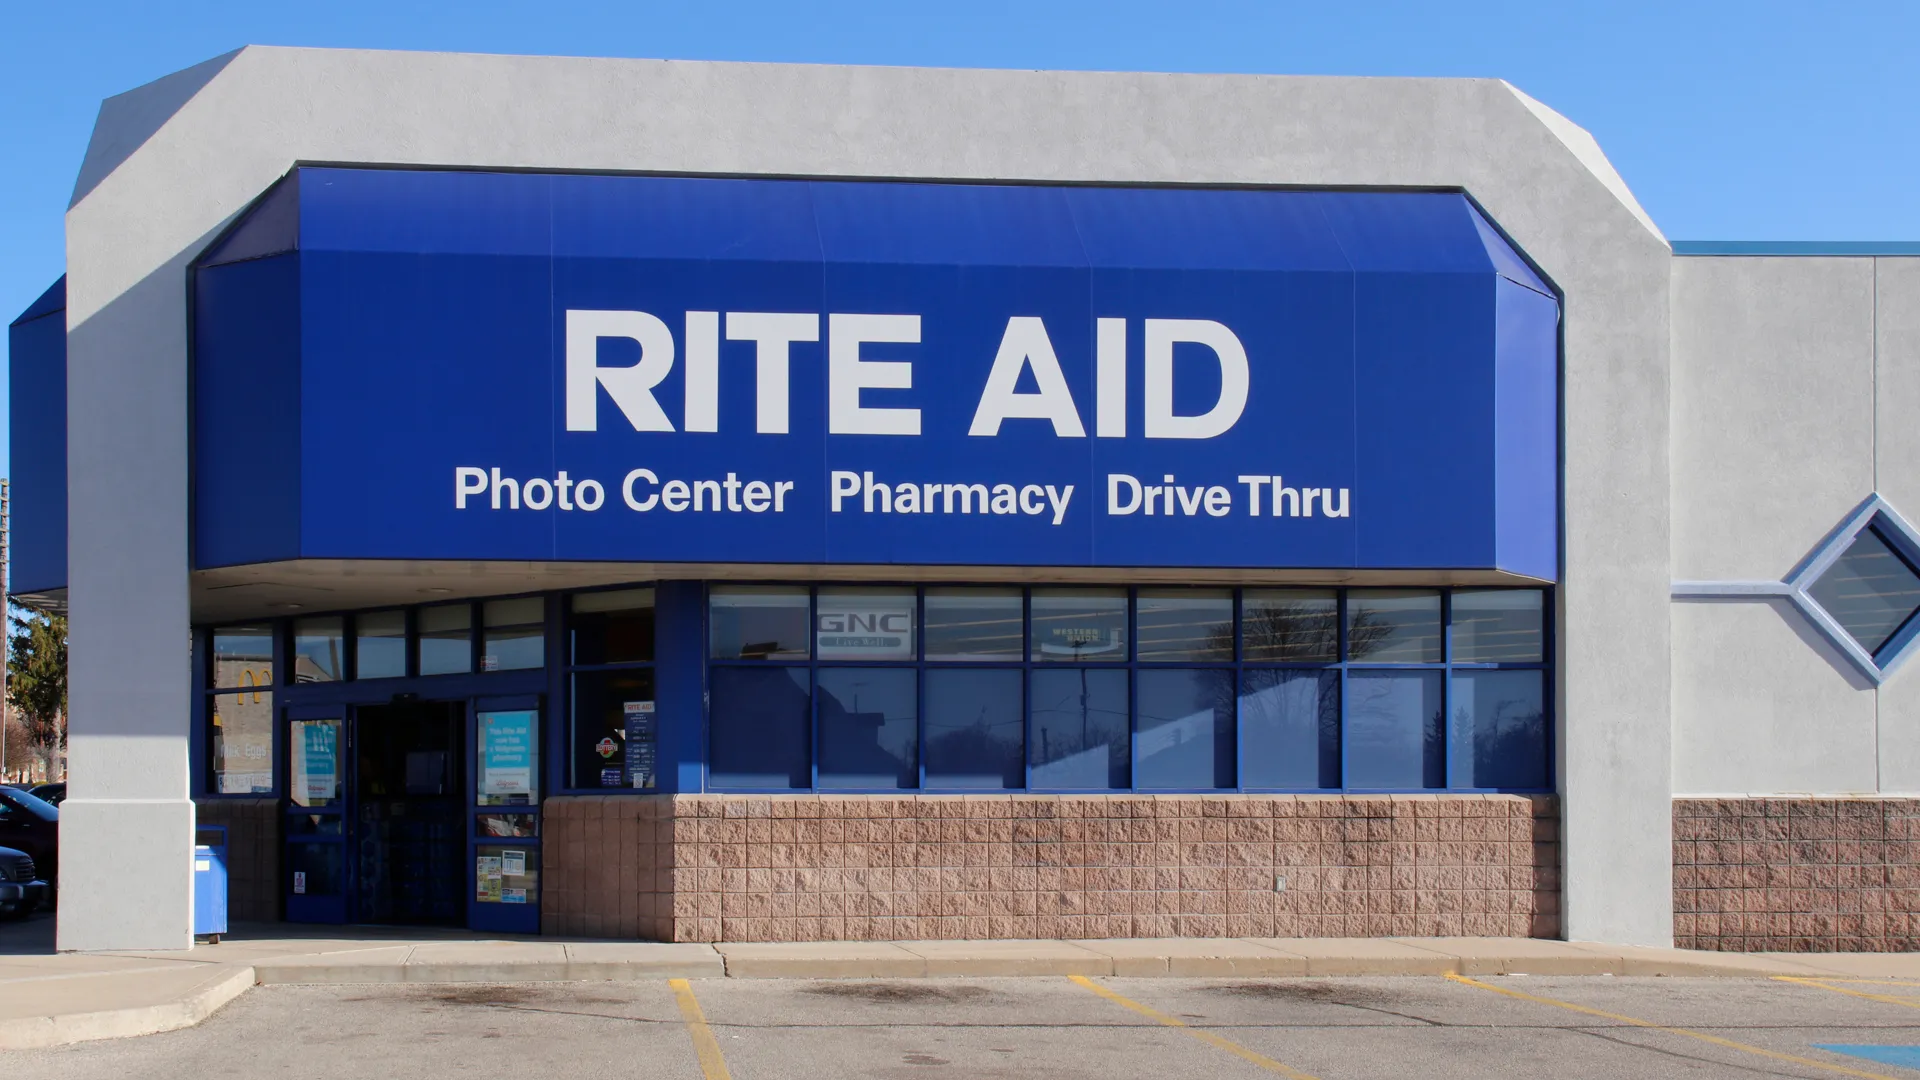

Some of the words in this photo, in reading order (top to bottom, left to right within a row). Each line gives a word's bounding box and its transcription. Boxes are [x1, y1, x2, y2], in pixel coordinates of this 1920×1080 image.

[566, 310, 921, 435] RITE
[968, 317, 1249, 438] AID
[456, 467, 604, 511] Photo
[623, 469, 793, 512] Center
[832, 471, 1074, 524] Pharmacy
[1108, 474, 1231, 516] Drive
[1238, 476, 1349, 517] Thru
[817, 613, 908, 633] GNC
[1052, 628, 1098, 636] WESTERN
[836, 638, 860, 646] Live
[245, 742, 267, 759] Eggs
